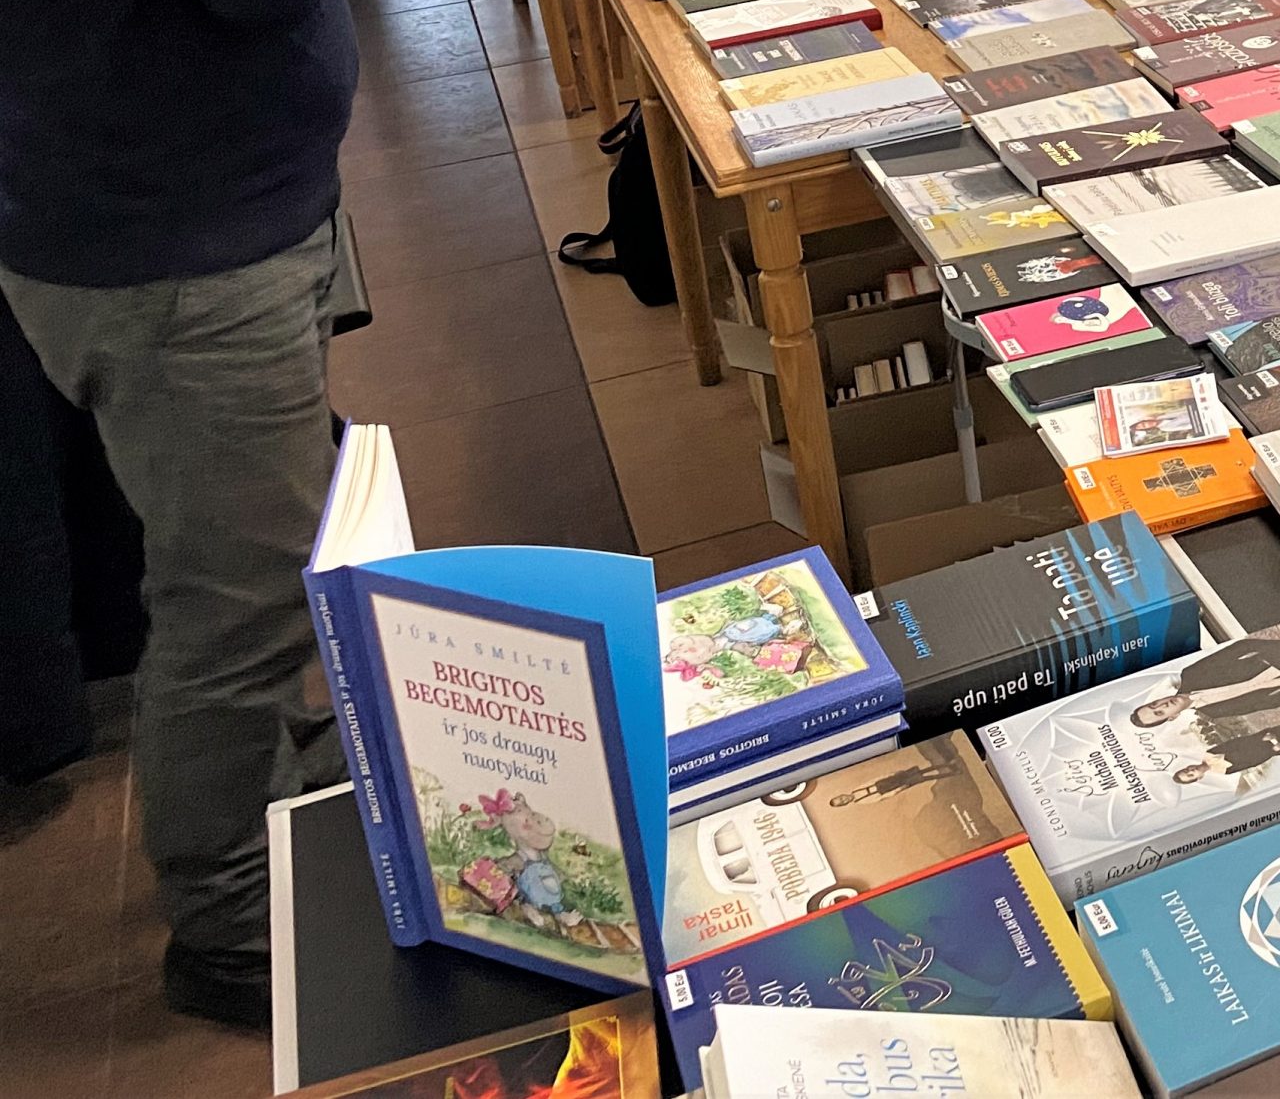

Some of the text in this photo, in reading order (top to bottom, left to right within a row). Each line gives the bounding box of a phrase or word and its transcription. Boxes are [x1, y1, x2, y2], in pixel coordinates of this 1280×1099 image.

[1197, 279, 1241, 320] Toli blizga
[395, 622, 572, 675] JŪRA SMILTĖ
[890, 599, 934, 659] Jaan Kaplinski
[1064, 635, 1151, 676] Jaan Kaplinski
[432, 660, 545, 706] BRIGITOS
[952, 668, 1055, 717] Ta pati upė
[404, 679, 587, 742] BEGEMOTAITĖS
[344, 700, 369, 776] BEGEMOTAITĖS
[442, 718, 558, 768] ir jos draugų
[720, 734, 770, 759] BRIGITOS
[988, 725, 1008, 750] 10,00
[462, 750, 549, 785] nuotykiai
[667, 751, 716, 777] BEGEMO
[1082, 749, 1122, 791] Michailo
[1088, 722, 1159, 805] Aleksandrovičiaus
[362, 778, 382, 824] BRIGITOS
[1015, 748, 1069, 838] LEONID MACHLIS
[753, 810, 811, 902] POBEDA 1946
[1164, 821, 1249, 860] Aleksandrovičiaus
[683, 898, 750, 928] Taska
[697, 914, 754, 943] Ilmar
[994, 897, 1016, 921] GÜLEN
[1158, 888, 1210, 953] LIKIMAI
[1003, 921, 1034, 959] FETHULLAH
[1199, 961, 1251, 1026] LAIKAS
[876, 1037, 920, 1093] bus
